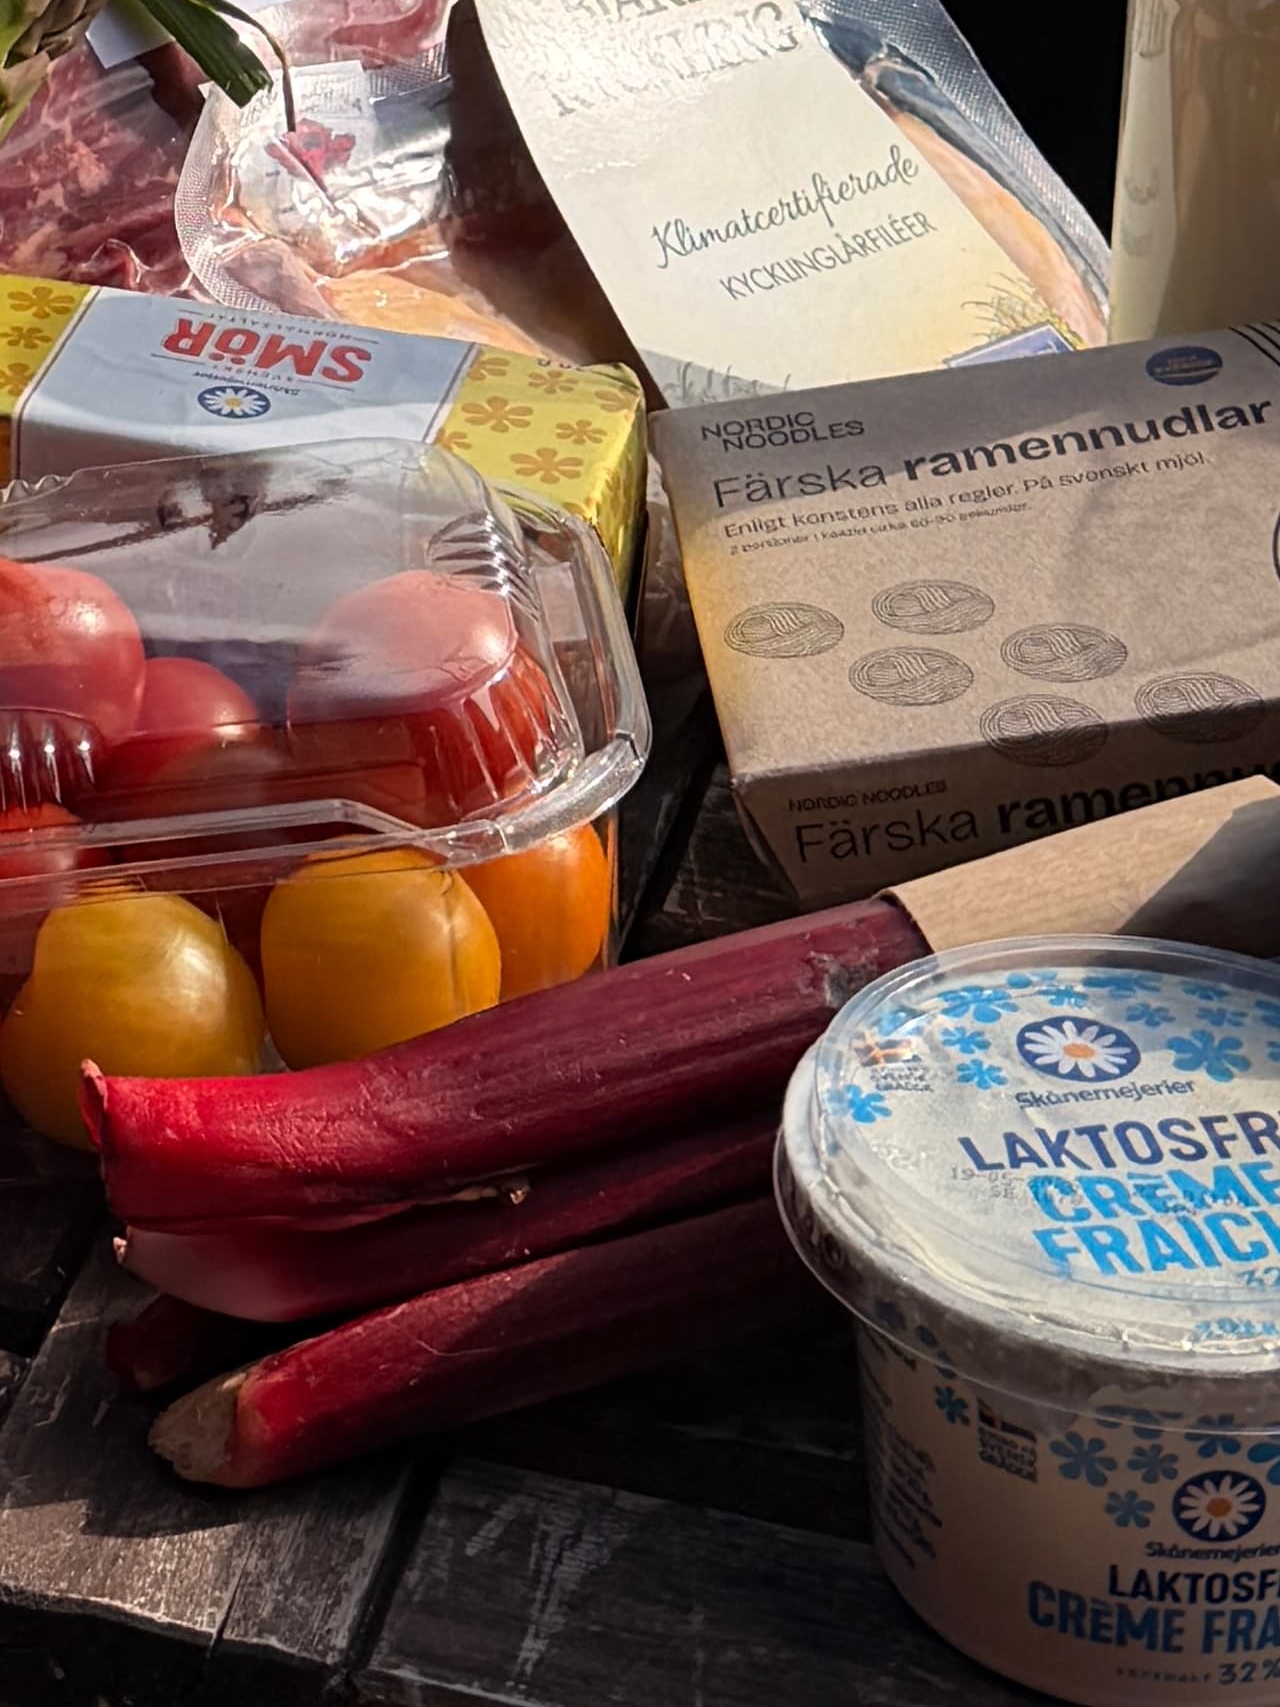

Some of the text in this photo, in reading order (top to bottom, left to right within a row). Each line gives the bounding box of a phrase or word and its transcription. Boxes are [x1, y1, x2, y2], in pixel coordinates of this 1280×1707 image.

[652, 145, 921, 270] Klimatcertifierade
[700, 411, 816, 439] NORDIC
[722, 419, 866, 452] NOODLES
[712, 399, 1272, 509] Färska ramennudlar
[724, 515, 786, 540] Enligt
[903, 493, 944, 514] alla
[1023, 474, 1055, 495] På
[793, 806, 981, 865] Färska
[1015, 1079, 1197, 1111] Skånemejerier
[957, 1110, 1280, 1172] LAKTOSFR
[1109, 1564, 1280, 1605] LAKTOSF
[1201, 1604, 1280, 1655] FRA
